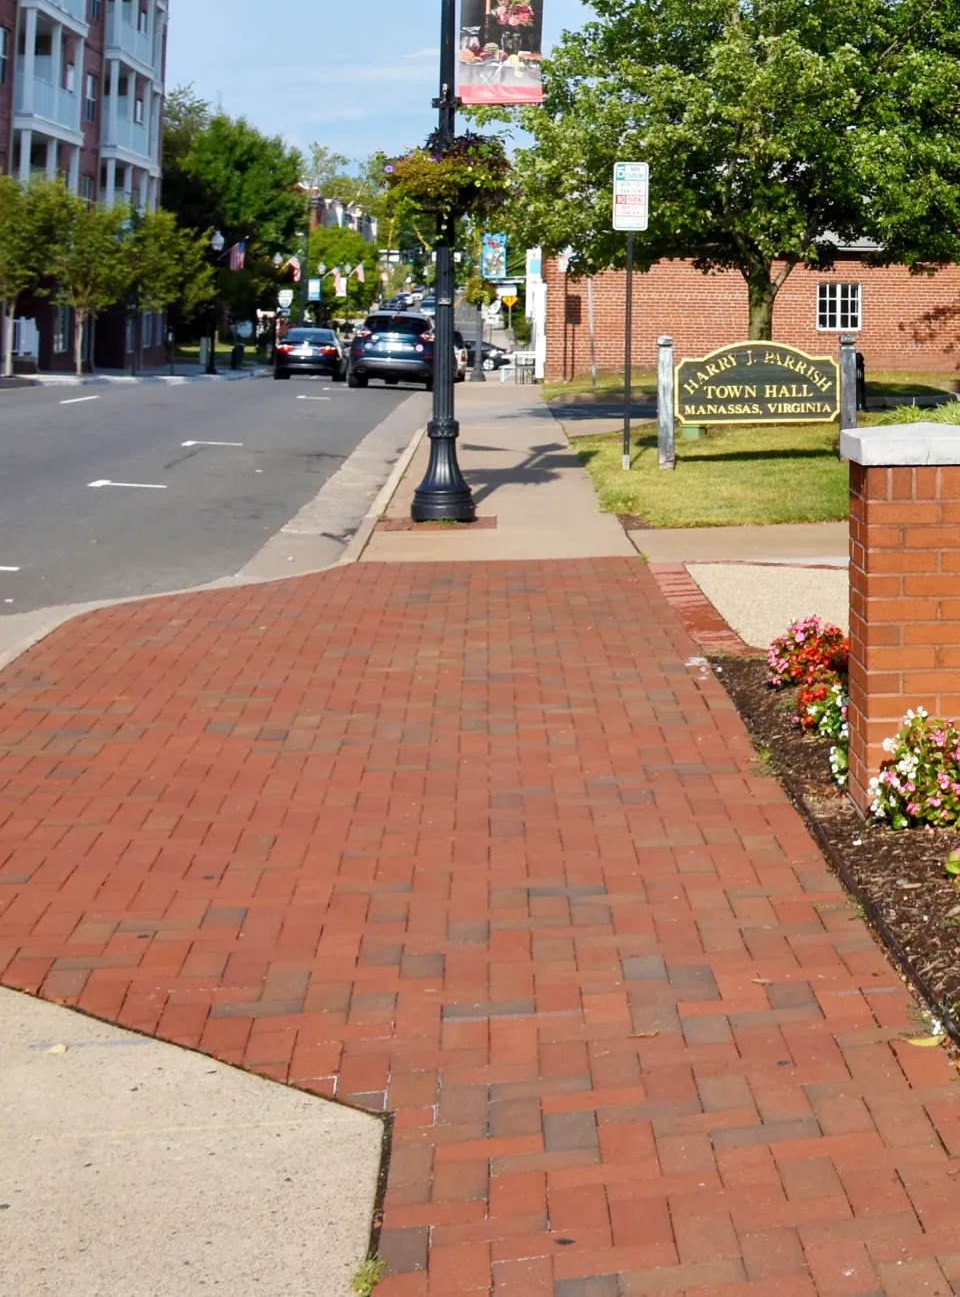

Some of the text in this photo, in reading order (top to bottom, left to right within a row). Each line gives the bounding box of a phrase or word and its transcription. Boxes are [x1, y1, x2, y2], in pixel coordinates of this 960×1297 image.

[683, 350, 833, 394] HARRY J. PARRISH
[703, 384, 813, 399] TOWN HALL
[684, 402, 831, 415] MANASSAS, VIRGINIA
